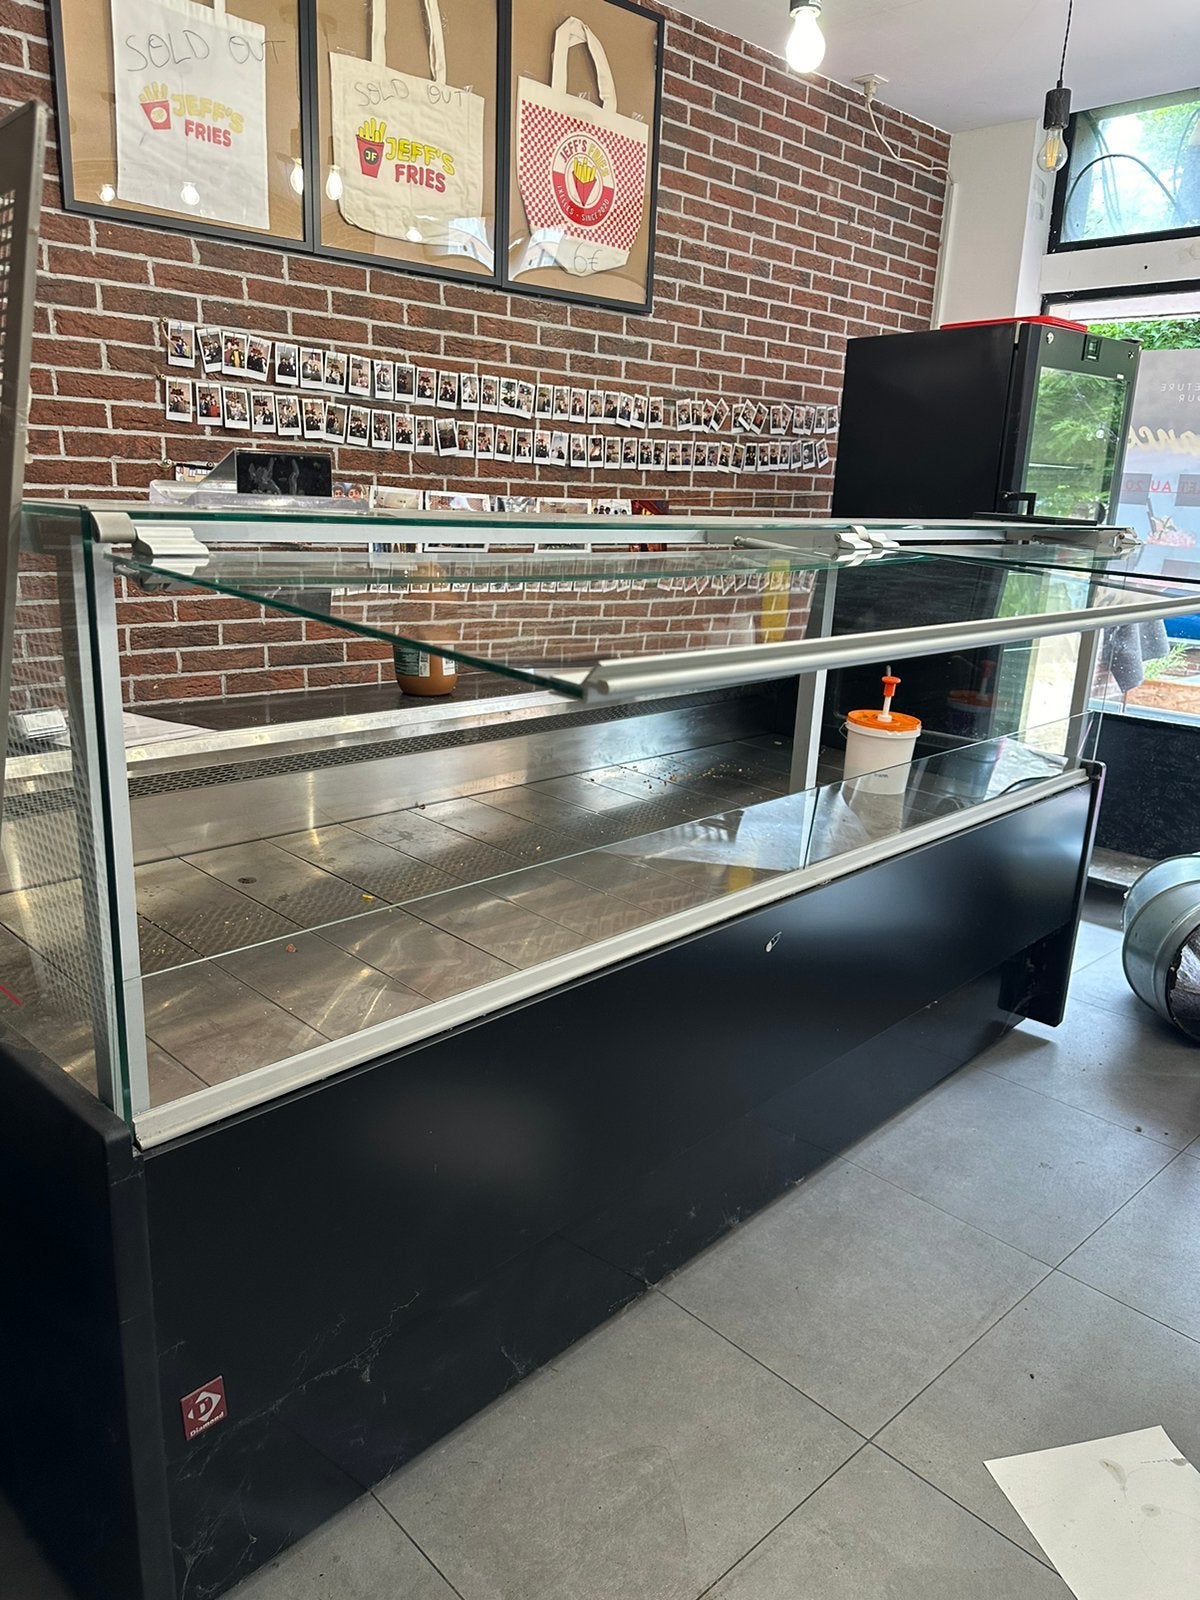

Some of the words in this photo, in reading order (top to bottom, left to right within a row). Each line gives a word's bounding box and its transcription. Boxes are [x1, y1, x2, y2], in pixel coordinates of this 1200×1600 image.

[125, 30, 210, 72] SOLD
[228, 35, 286, 64] OUT
[354, 78, 410, 107] SOLD
[427, 84, 469, 107] OUT
[171, 93, 245, 134] JEFF'S
[184, 118, 232, 148] FRIES
[365, 151, 379, 162] JF
[385, 137, 456, 176] JEFF'S
[560, 138, 589, 164] JEFF'S
[394, 163, 447, 194] FRIES
[557, 184, 576, 216] IXELLES
[581, 211, 599, 222] SINCE
